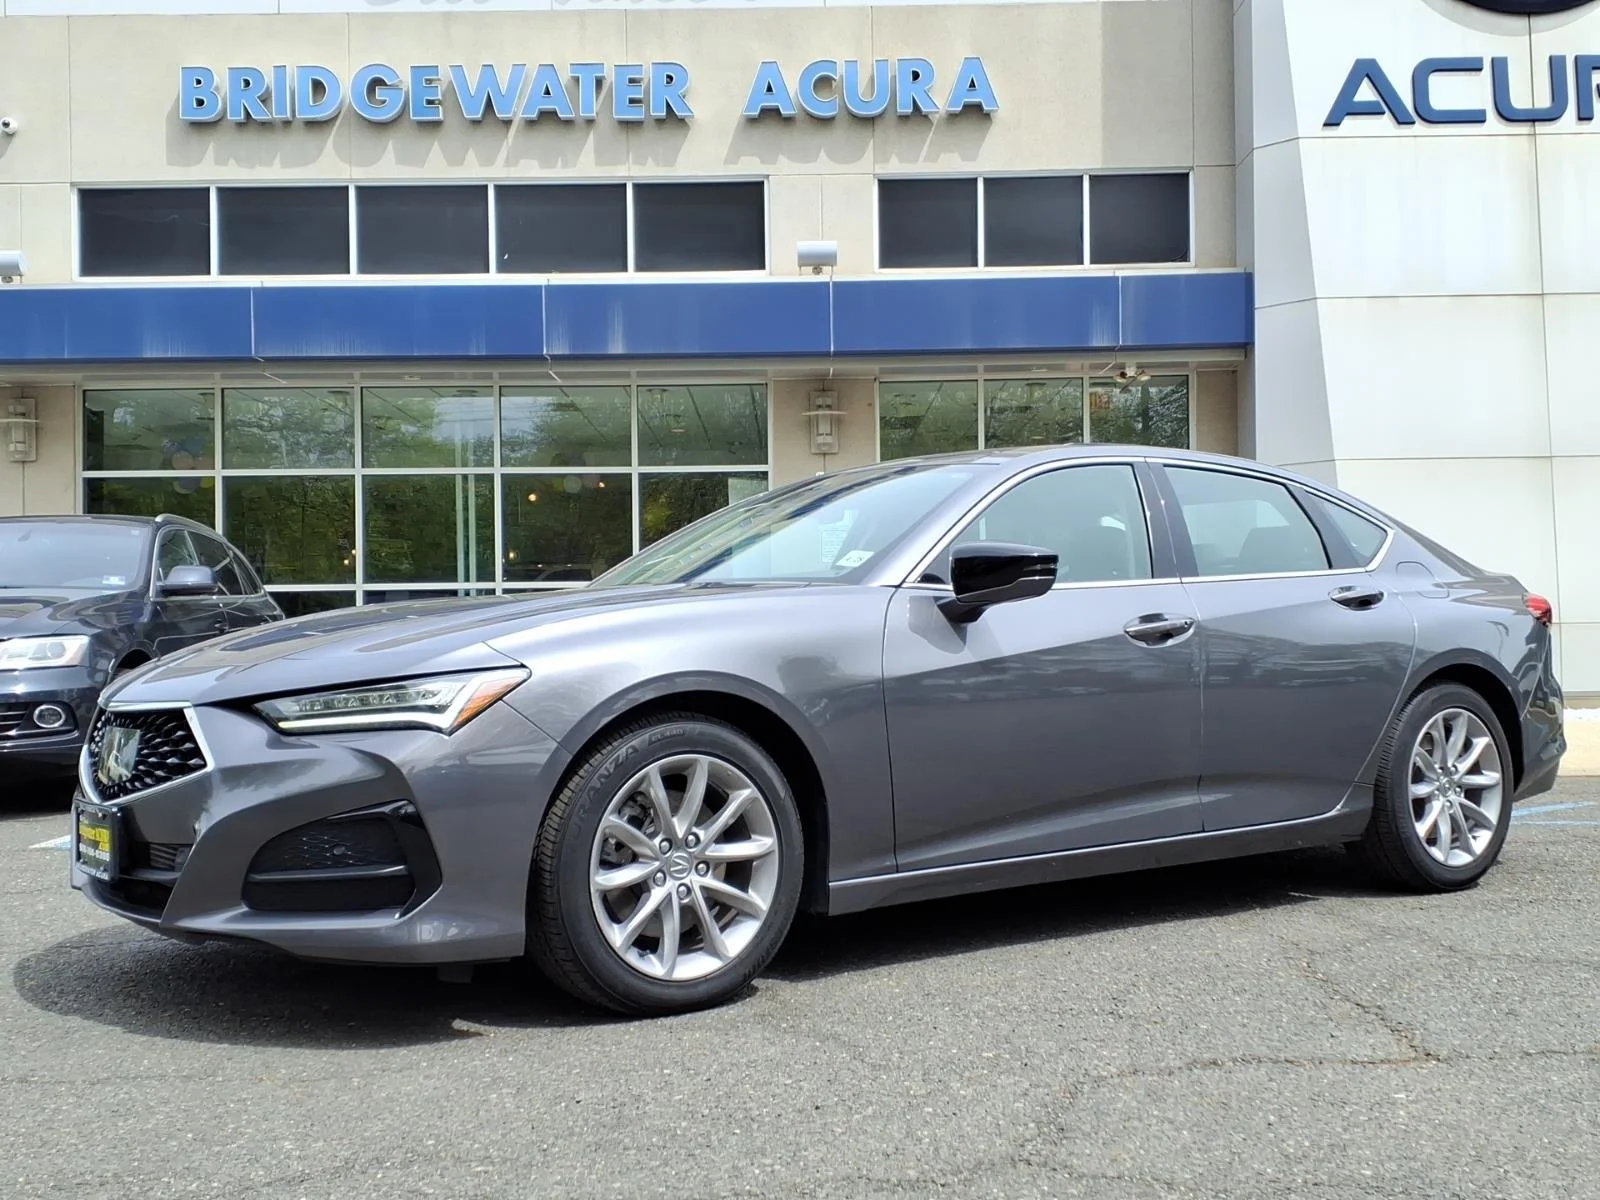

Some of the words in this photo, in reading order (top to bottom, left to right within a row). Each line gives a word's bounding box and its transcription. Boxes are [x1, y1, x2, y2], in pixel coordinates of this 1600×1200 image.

[179, 61, 694, 124] BRIDGEWATER
[744, 56, 998, 118] ACURA
[568, 743, 641, 846] URANZA
